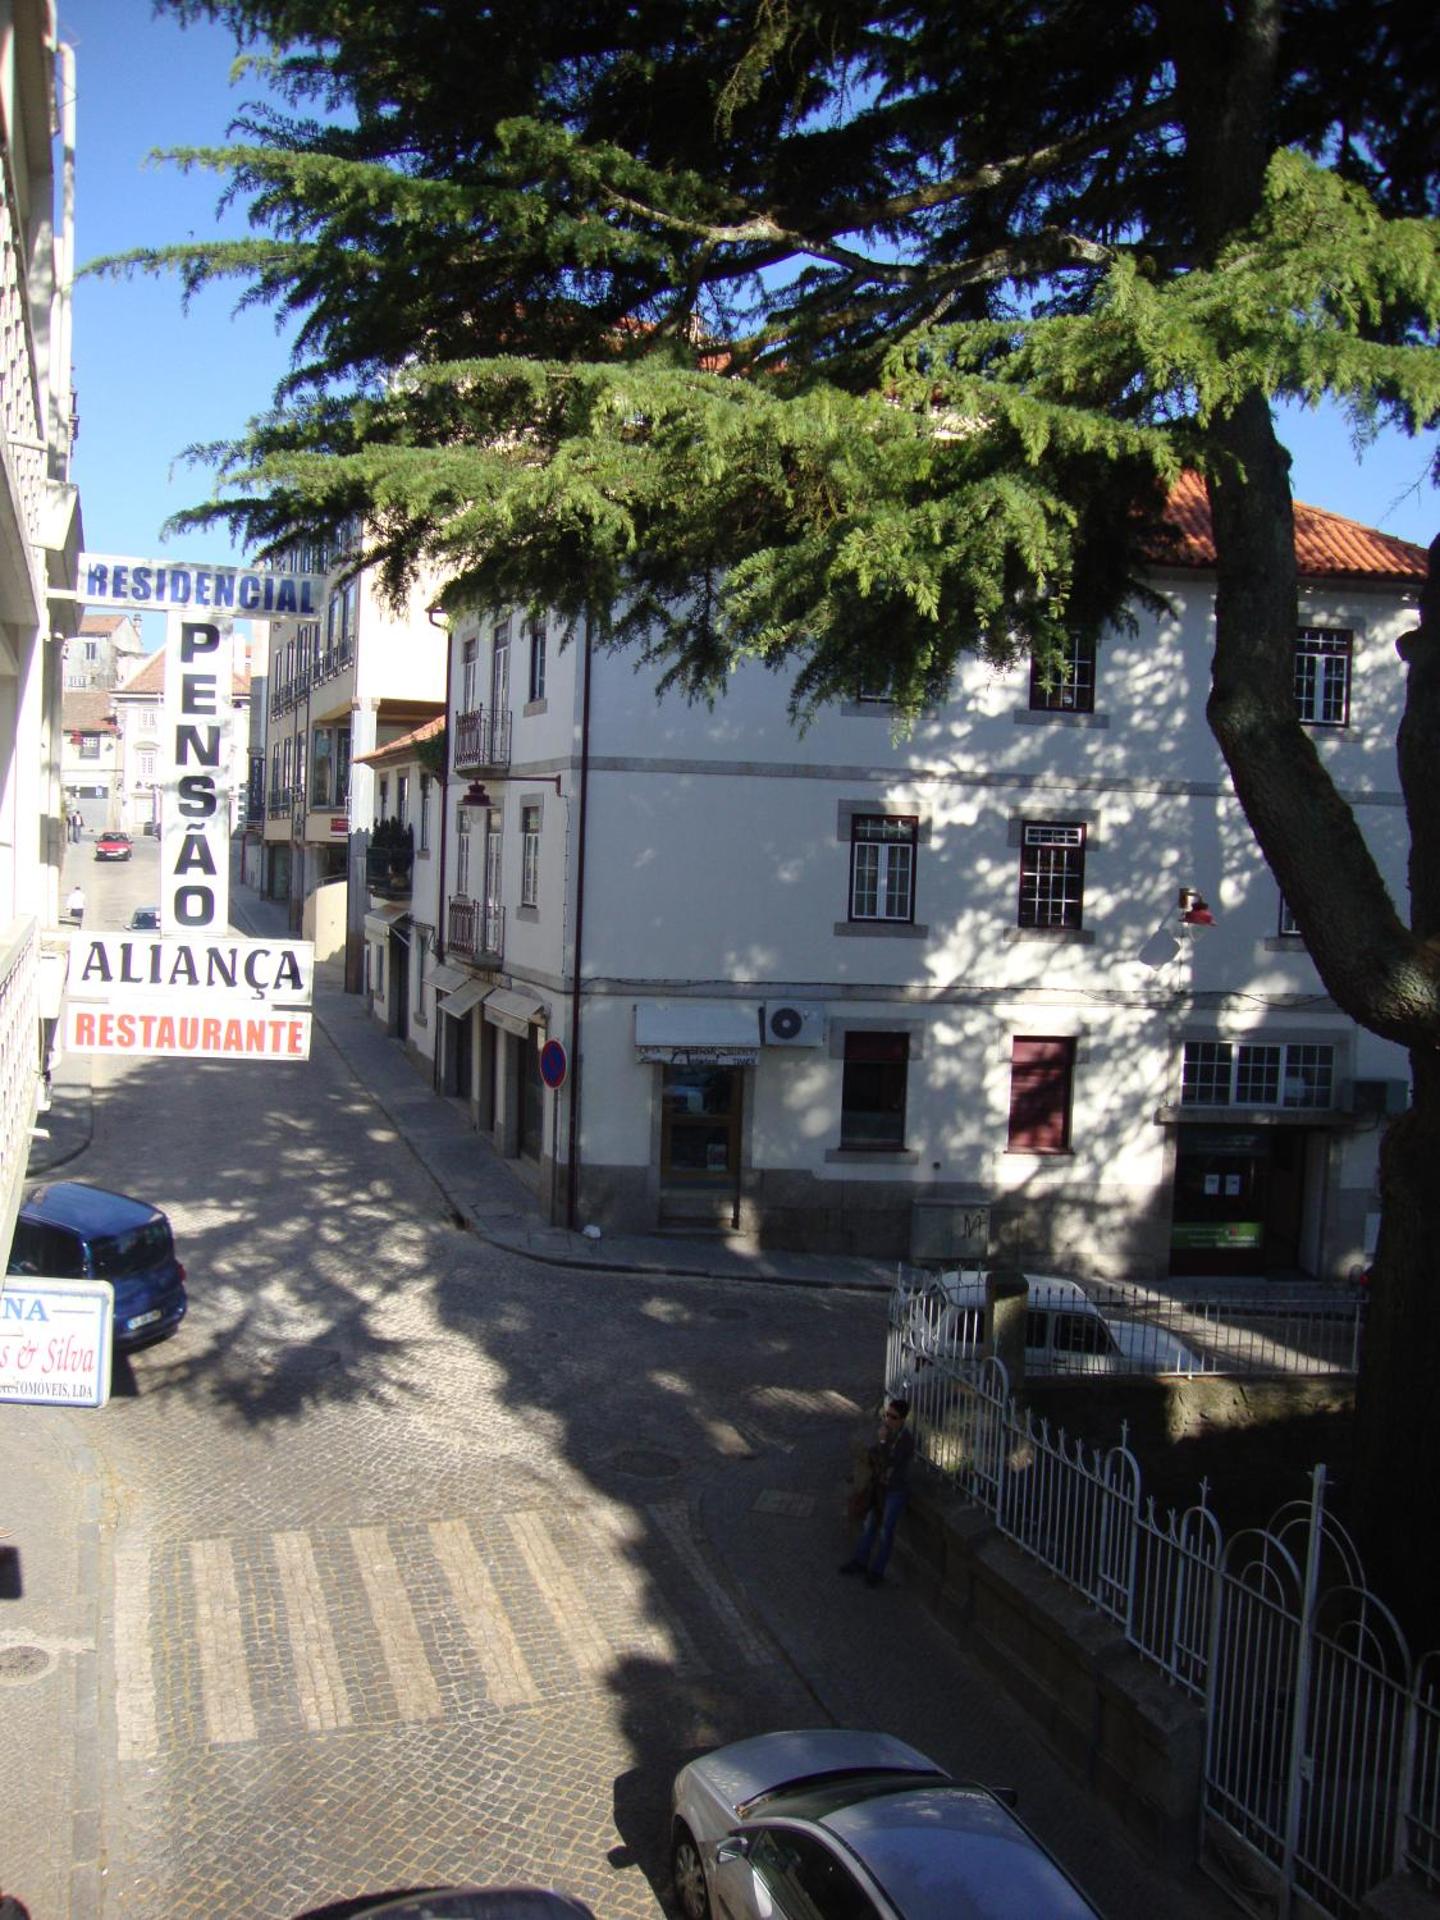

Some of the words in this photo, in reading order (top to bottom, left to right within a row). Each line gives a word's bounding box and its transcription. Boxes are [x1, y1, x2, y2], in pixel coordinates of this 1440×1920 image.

[87, 562, 315, 614] RESIDENCIAL
[173, 622, 220, 927] PENSÃO
[82, 941, 304, 1000] ALIANÇA
[75, 1012, 304, 1055] RESTAURANTE
[0, 1296, 50, 1322] NA
[41, 1334, 95, 1374] Silva
